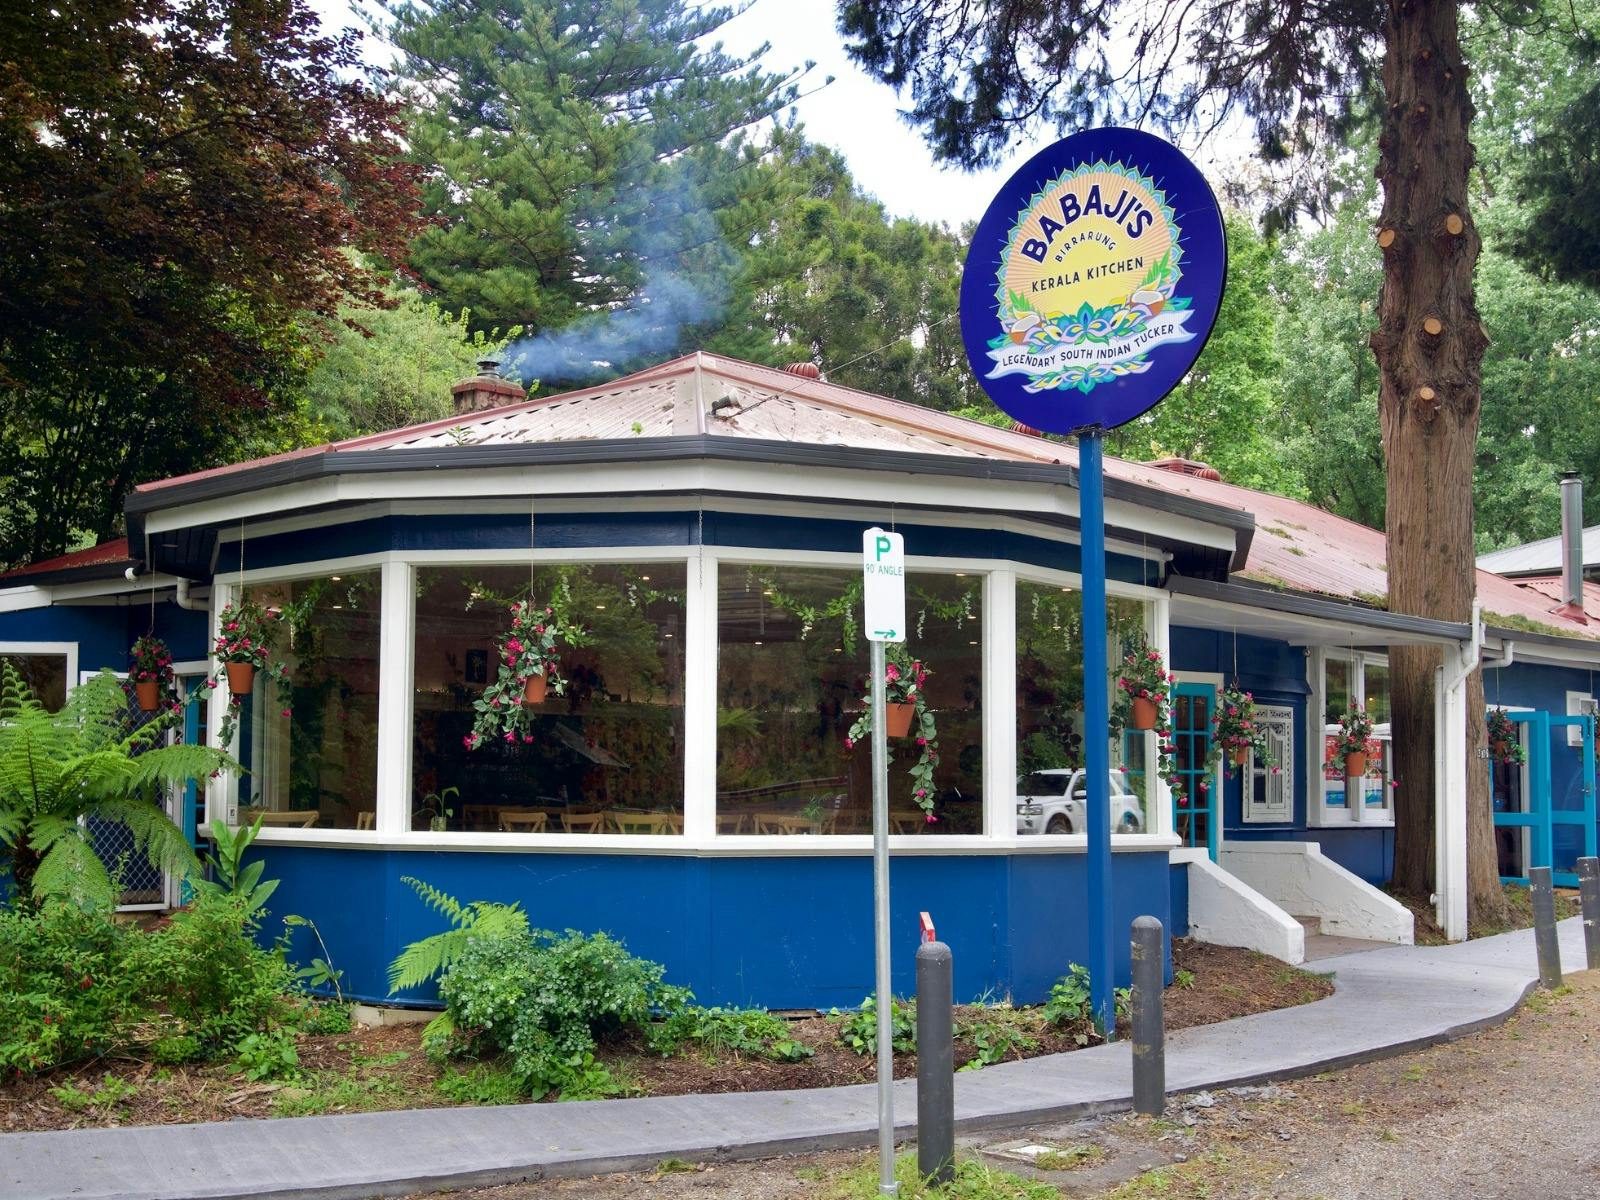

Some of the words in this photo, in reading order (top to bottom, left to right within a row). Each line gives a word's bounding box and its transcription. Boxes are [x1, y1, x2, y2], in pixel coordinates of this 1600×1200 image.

[1021, 184, 1153, 263] BABAJI'S
[1055, 231, 1116, 262] BIRRARUNG
[1032, 272, 1081, 292] KERALA
[1087, 257, 1143, 279] KITCHEN
[1002, 355, 1056, 368] LEGENDARY
[1061, 349, 1093, 361] SOUTH
[1096, 343, 1131, 359] INDIAN
[1135, 323, 1174, 348] TUCKER
[876, 536, 891, 561] P
[878, 565, 903, 576] ANGLE
